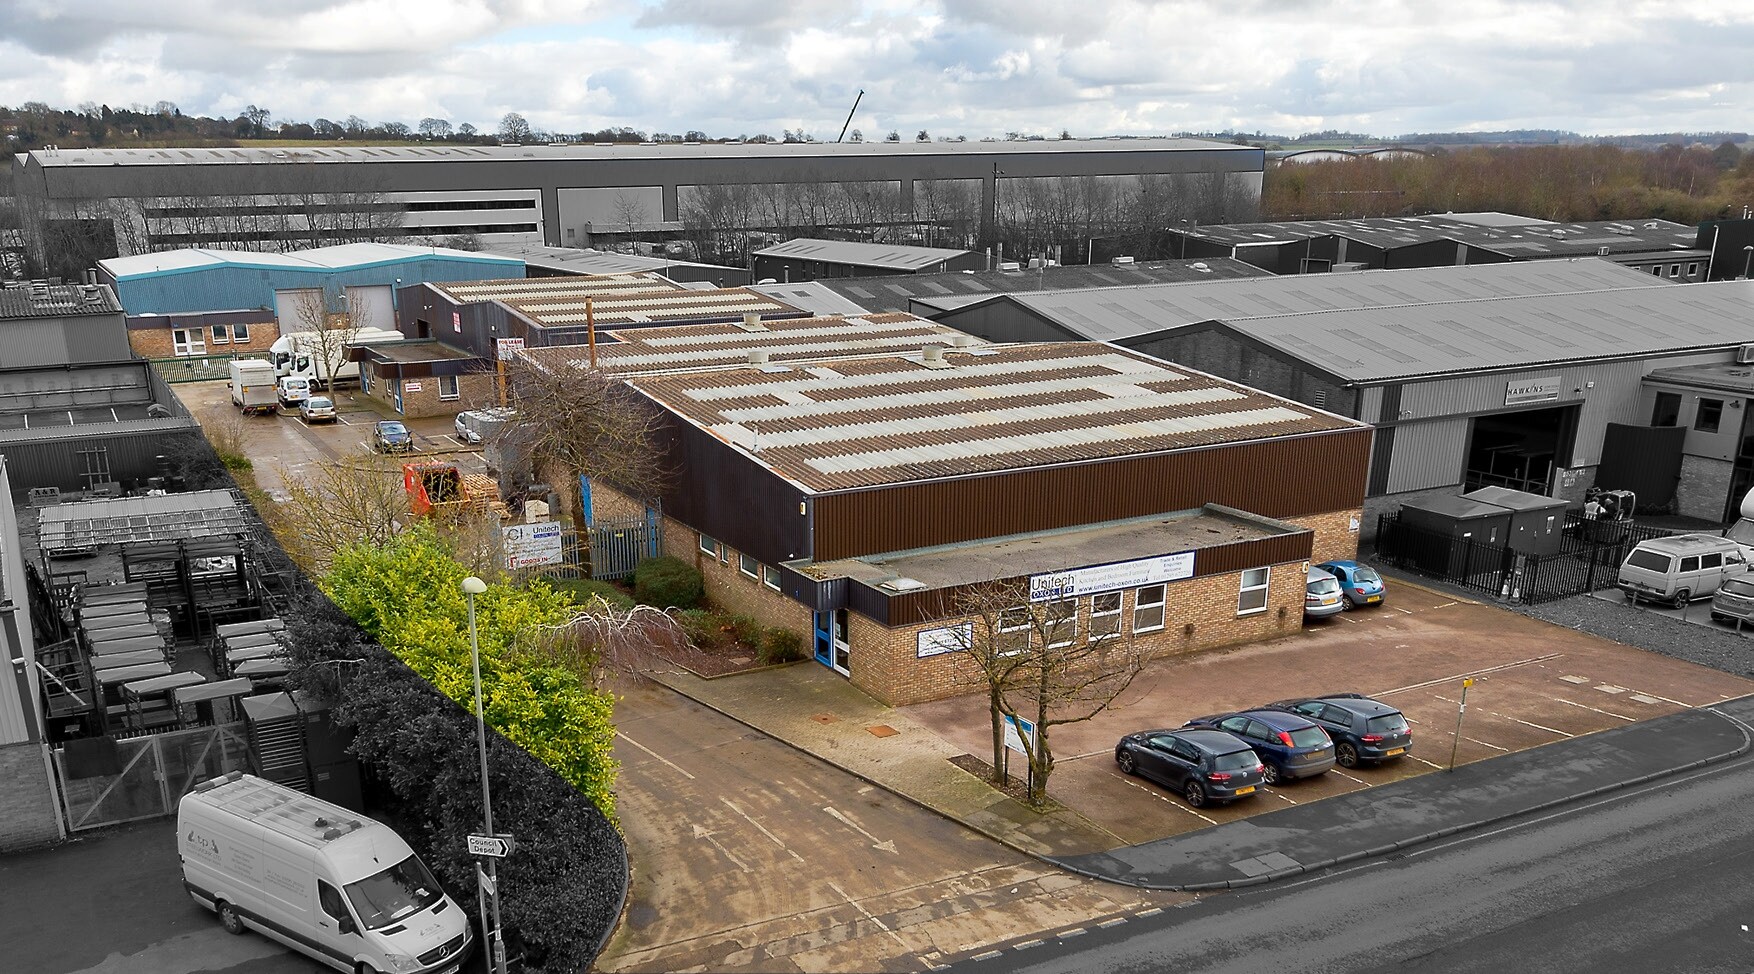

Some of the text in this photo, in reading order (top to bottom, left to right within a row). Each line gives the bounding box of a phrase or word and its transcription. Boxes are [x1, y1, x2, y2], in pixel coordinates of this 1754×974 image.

[1507, 383, 1543, 396] HAWKINS
[532, 525, 560, 534] Unitech
[1032, 574, 1075, 591] Unitech
[1078, 576, 1149, 592] www.unitech-oxon.co.uk
[469, 838, 497, 847] Council
[474, 845, 496, 854] Depot
